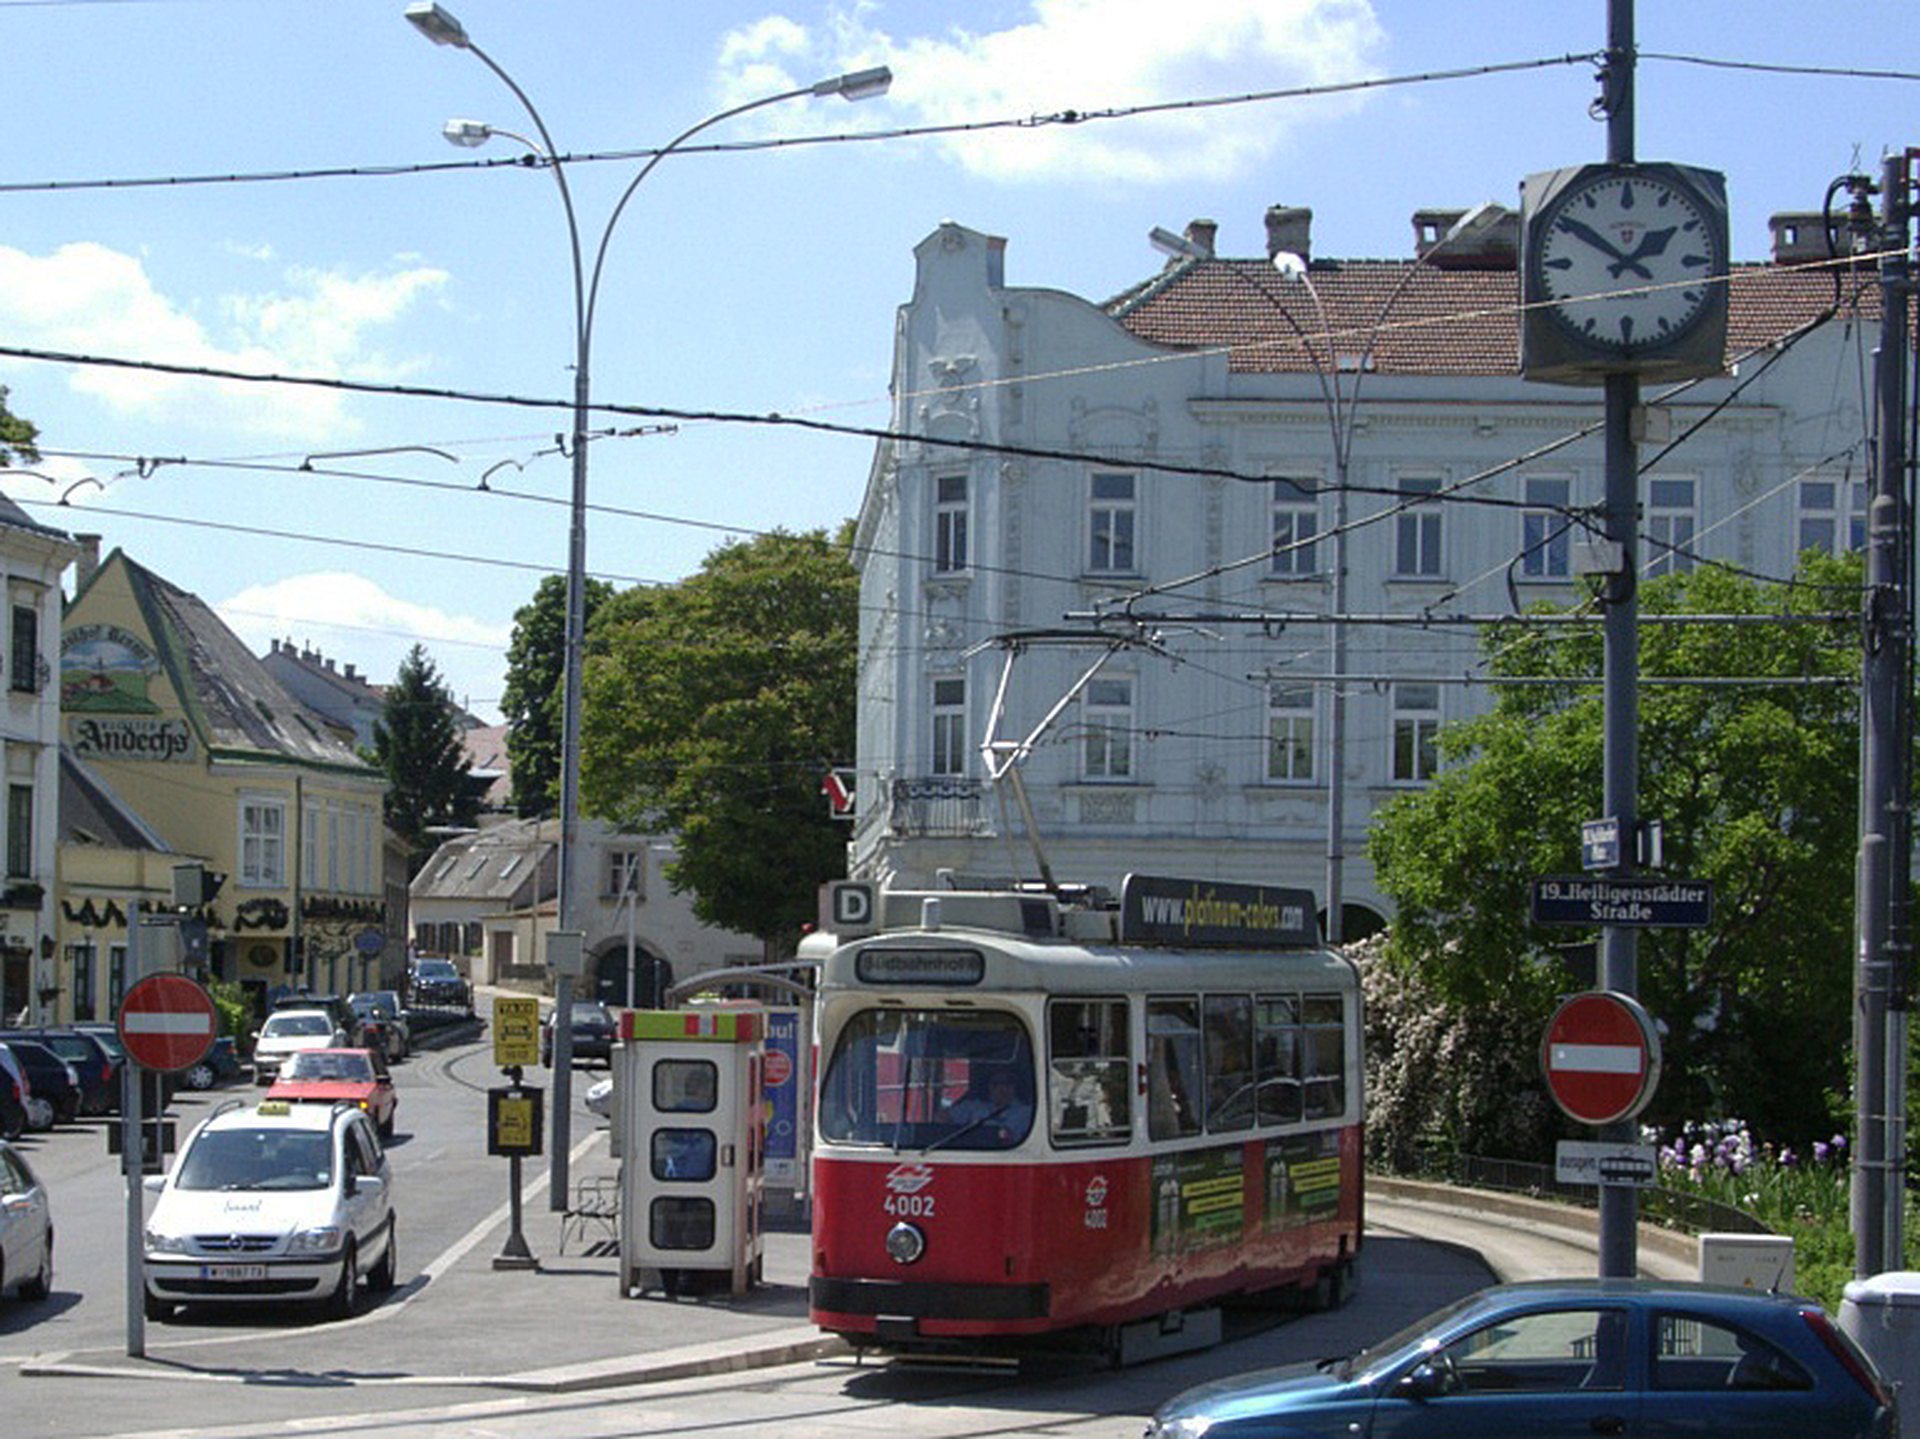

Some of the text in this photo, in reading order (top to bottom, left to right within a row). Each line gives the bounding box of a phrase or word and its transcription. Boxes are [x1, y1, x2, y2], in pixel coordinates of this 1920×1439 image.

[75, 719, 190, 760] Andechs
[840, 889, 868, 921] D
[1590, 903, 1652, 920] Straße
[884, 1195, 936, 1217] 4002
